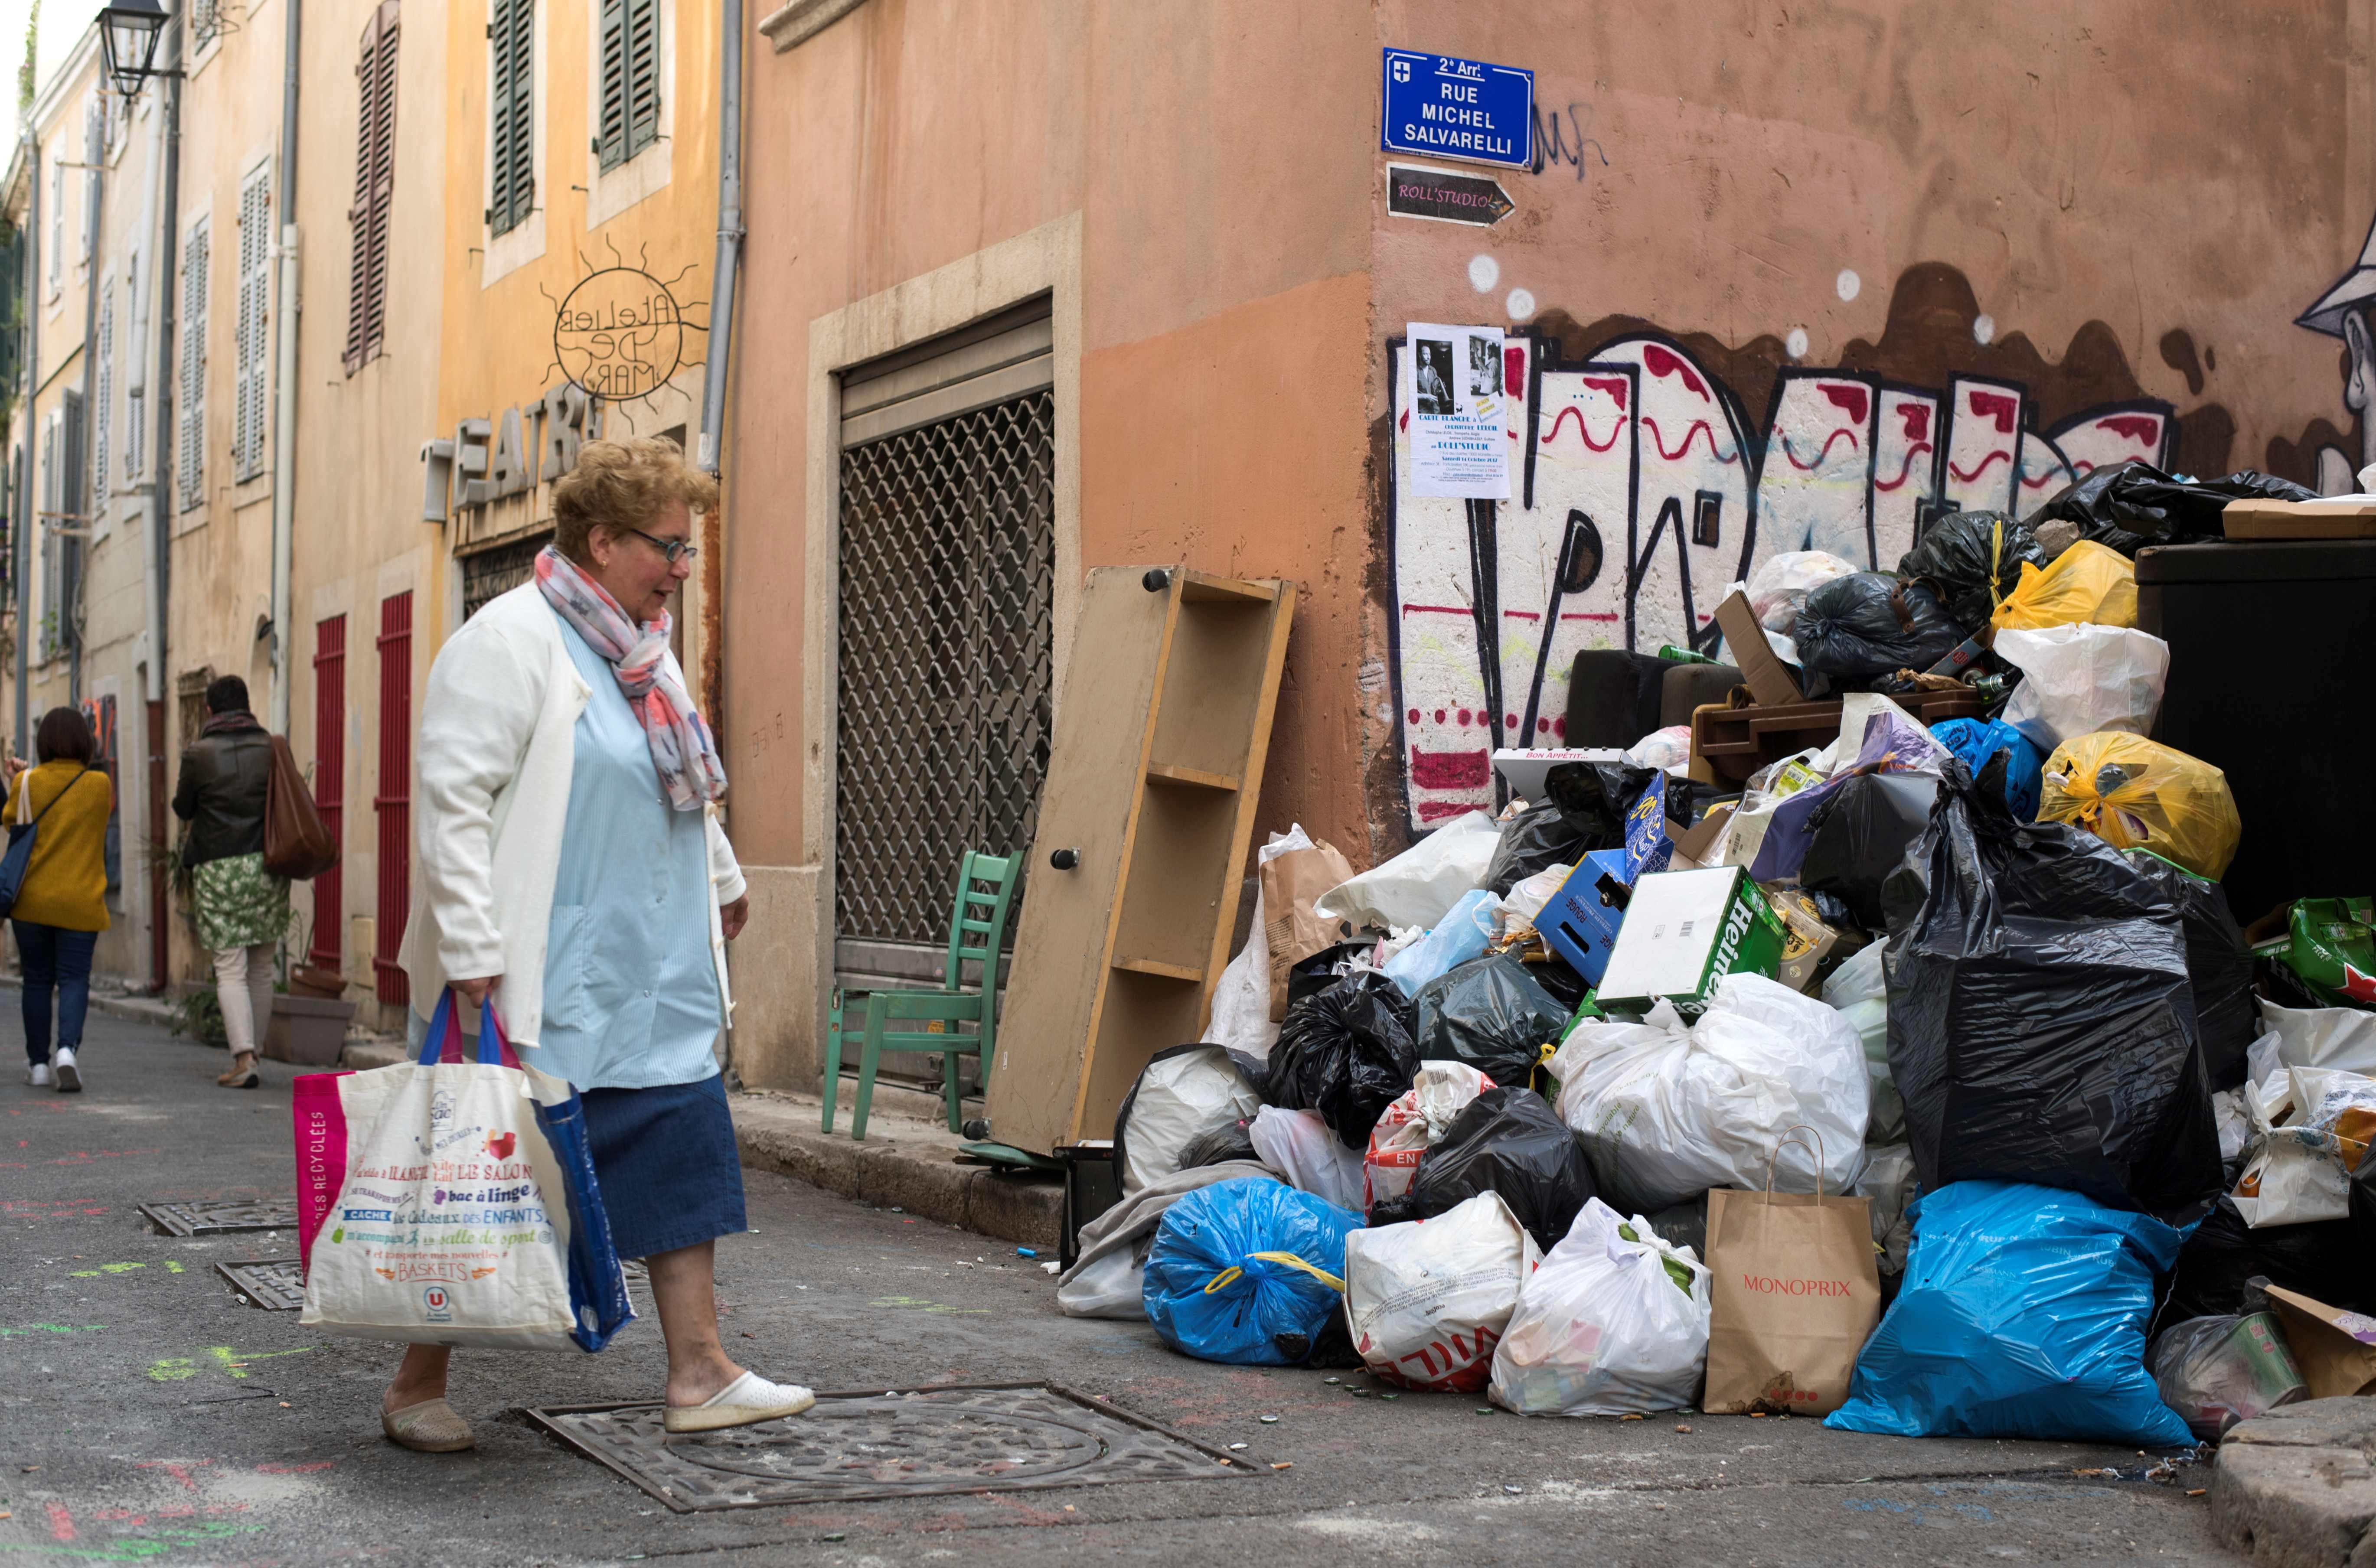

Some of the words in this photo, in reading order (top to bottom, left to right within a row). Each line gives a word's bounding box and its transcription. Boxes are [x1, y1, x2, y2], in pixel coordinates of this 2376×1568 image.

[1441, 82, 1478, 104] RUE
[1422, 103, 1495, 130] MICHEL
[1404, 124, 1511, 154] SALVARELLI
[1399, 185, 1488, 208] ROLL'STUDIO
[1438, 441, 1491, 450] ROLL'STUDIO
[1566, 898, 1588, 924] ROUGE
[1622, 1105, 1641, 1131] nature
[310, 1112, 326, 1190] RECYCLÉES
[1397, 1153, 1416, 1164] EN
[457, 1164, 478, 1180] LE
[484, 1163, 532, 1180] SALON
[449, 1190, 473, 1202] bac
[477, 1190, 486, 1202] à
[488, 1185, 531, 1203] linge
[350, 1211, 387, 1220] CACHE
[463, 1214, 481, 1223] DES
[483, 1208, 543, 1224] ENFANTS
[439, 1229, 474, 1245] salle
[479, 1229, 496, 1244] de
[501, 1229, 535, 1249] sport
[450, 1249, 499, 1259] nouvelles
[398, 1262, 467, 1282] BASKETS
[1744, 1273, 1851, 1297] MONOPRIX
[429, 1293, 444, 1306] U
